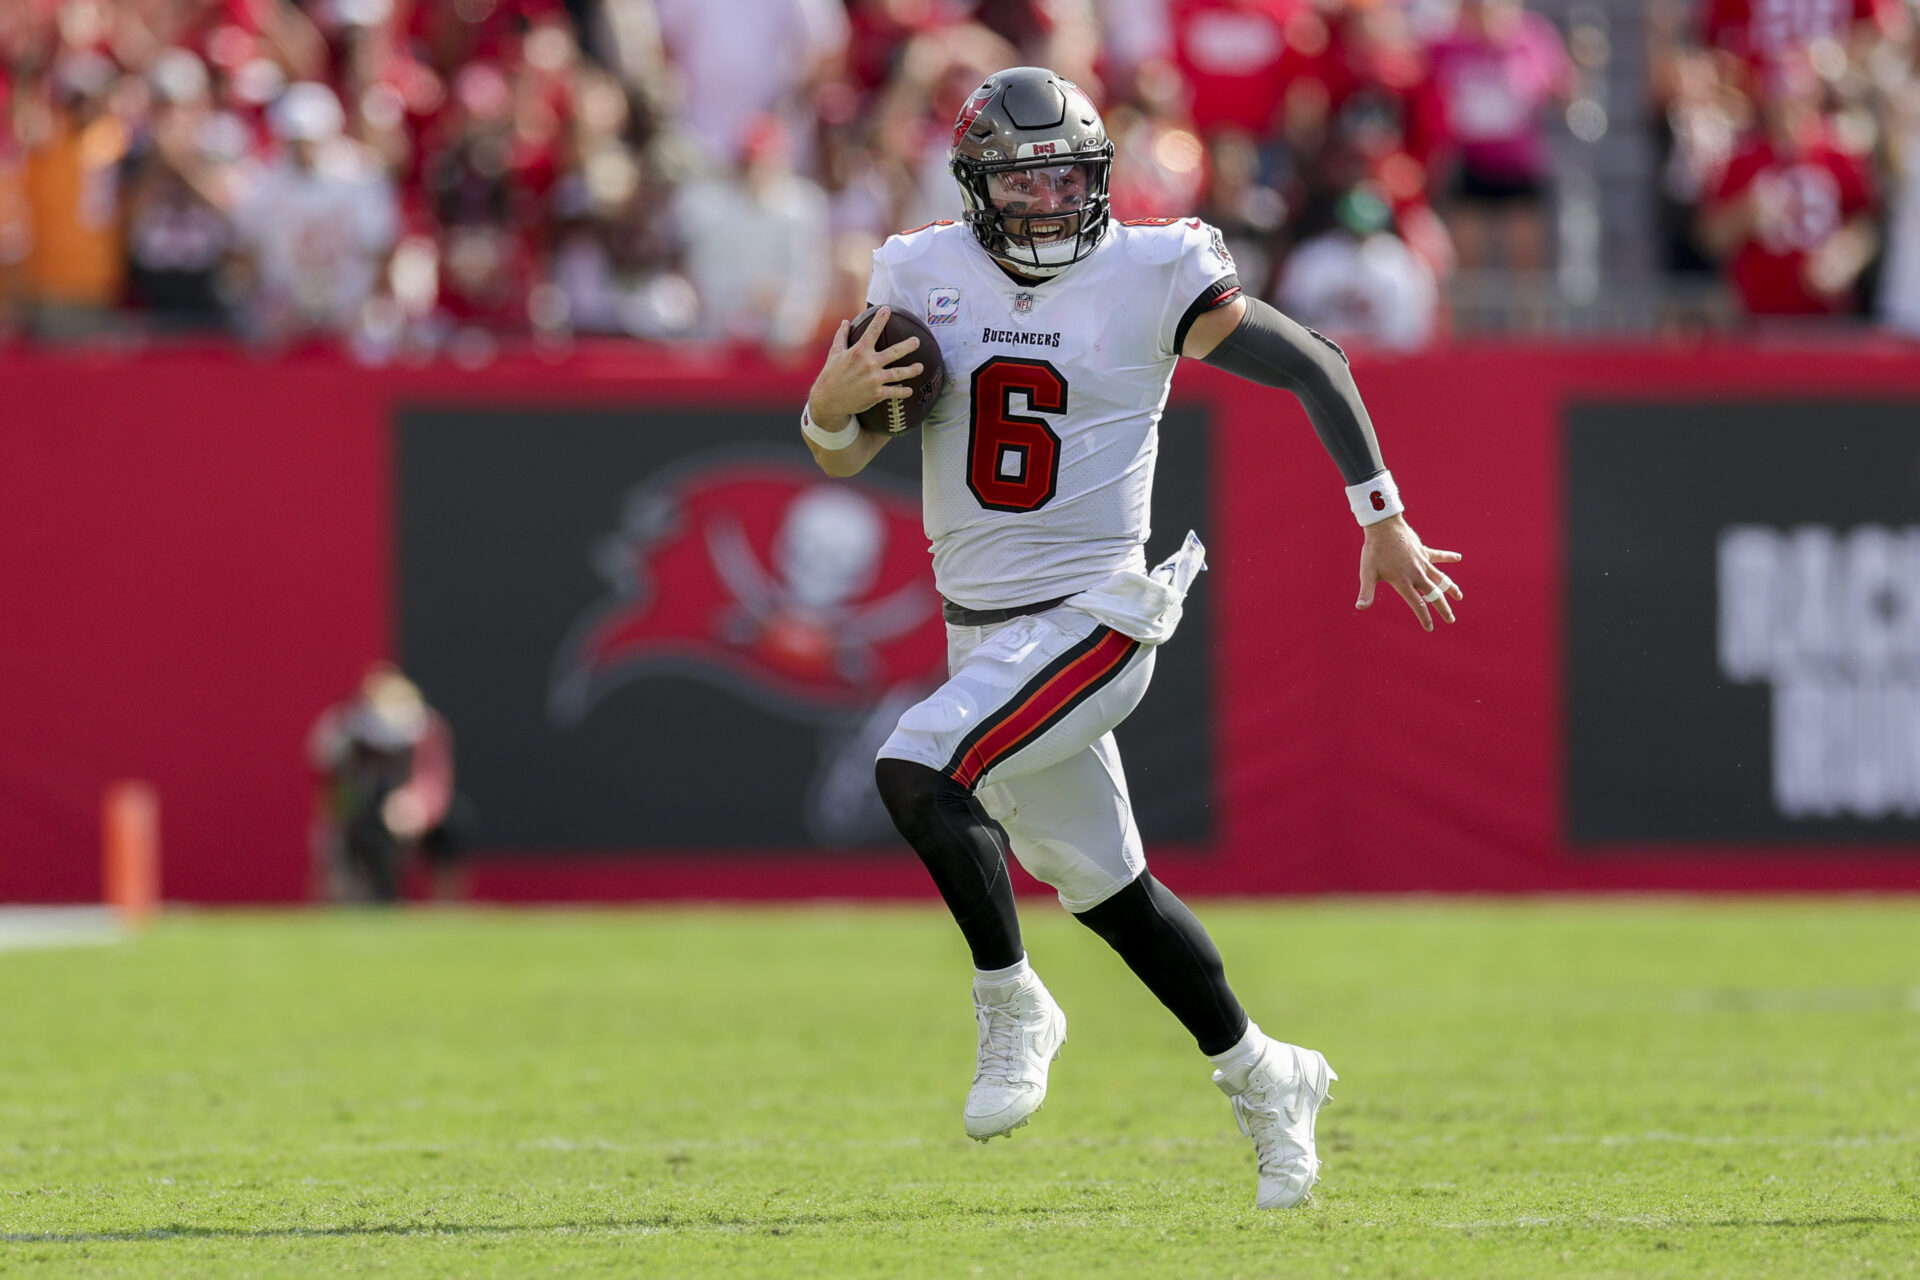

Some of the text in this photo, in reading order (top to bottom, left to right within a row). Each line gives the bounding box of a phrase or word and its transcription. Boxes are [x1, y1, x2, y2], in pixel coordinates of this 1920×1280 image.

[1016, 300, 1030, 310] NFL
[982, 328, 1060, 347] BUCCANEERS
[966, 355, 1068, 513] 6
[1370, 490, 1385, 511] 6
